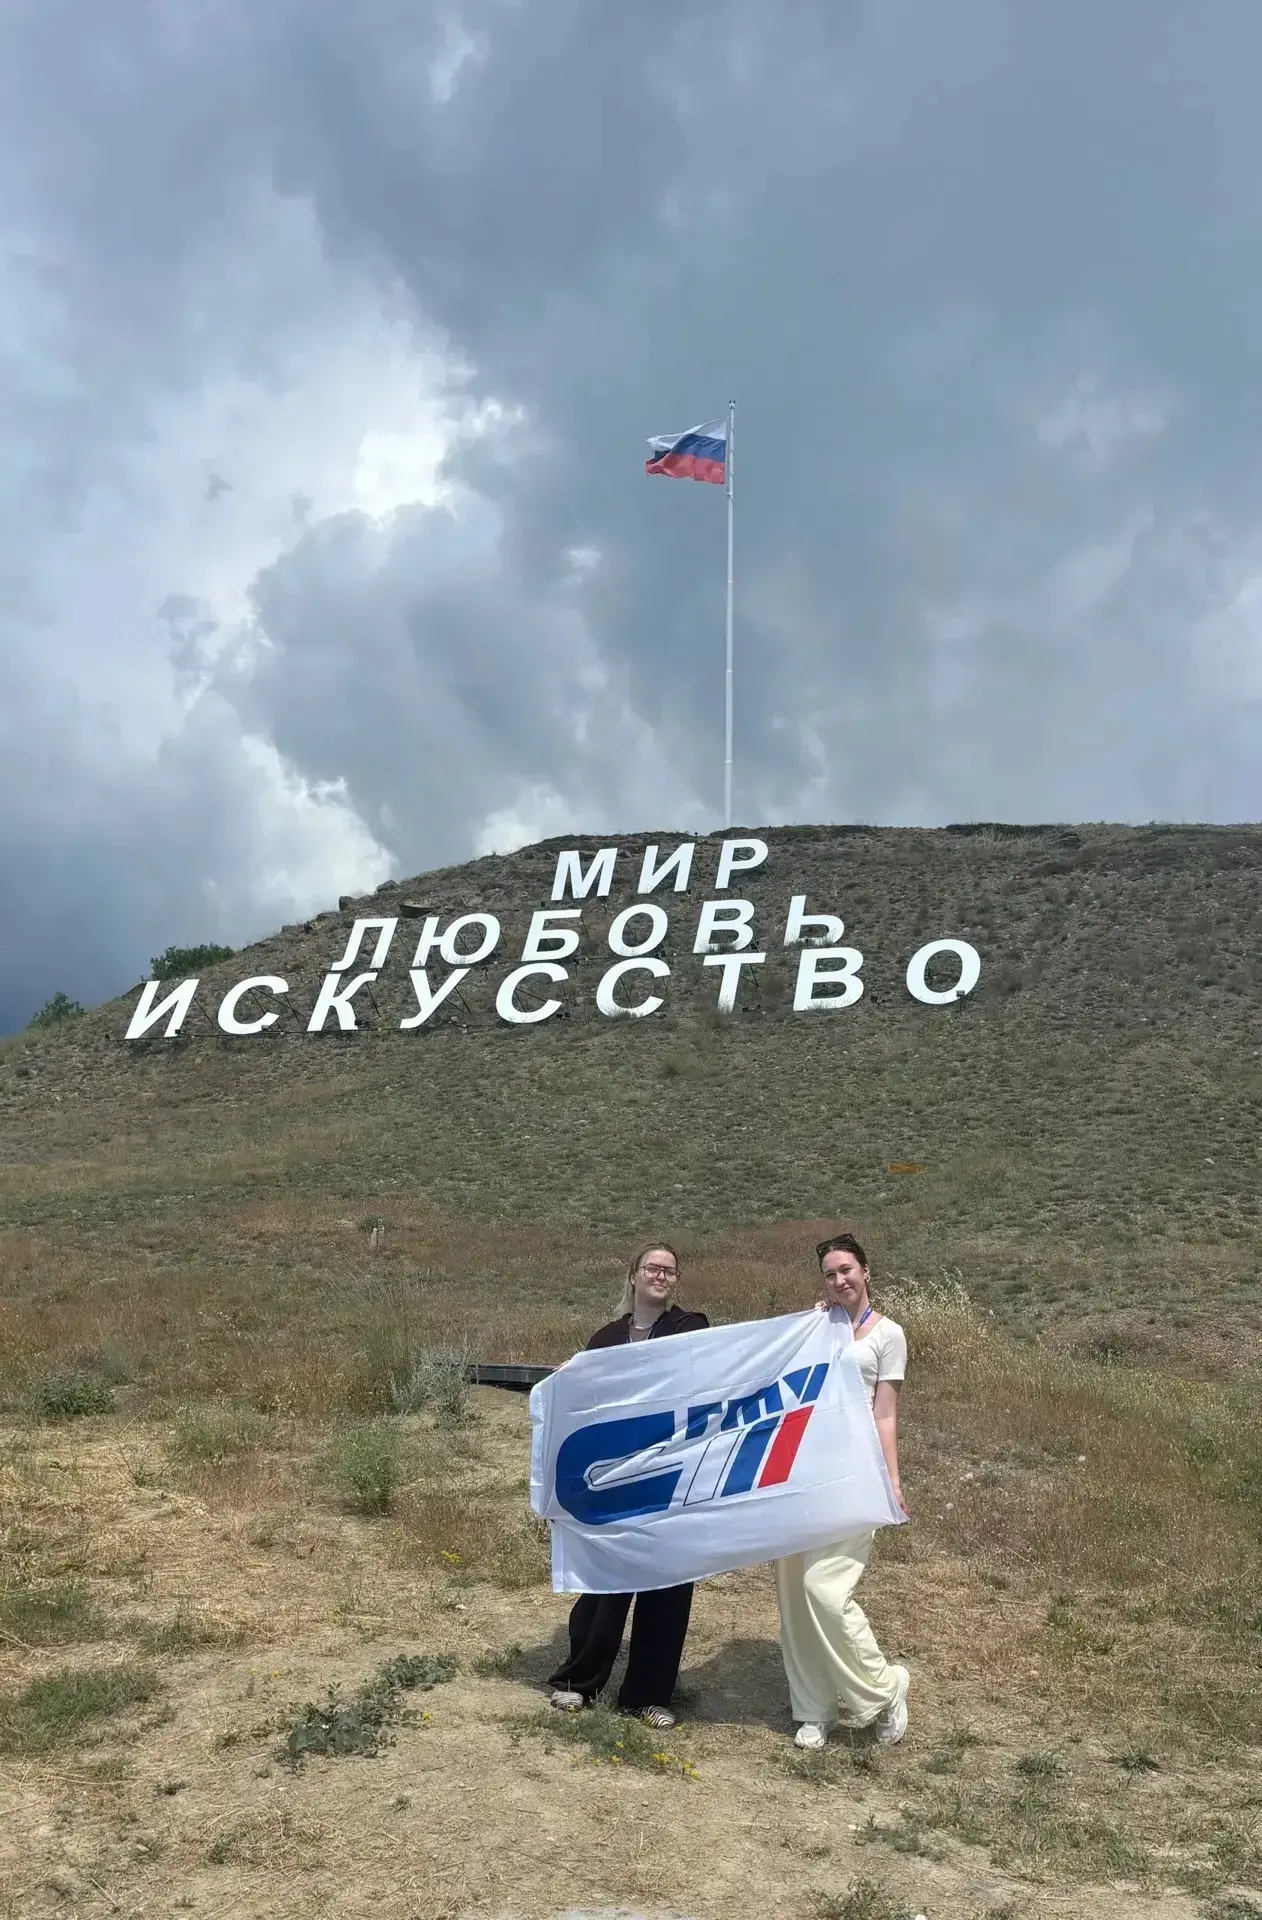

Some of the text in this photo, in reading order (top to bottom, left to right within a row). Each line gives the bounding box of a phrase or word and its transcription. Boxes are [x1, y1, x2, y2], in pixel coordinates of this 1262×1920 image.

[550, 838, 769, 901] МИР
[330, 894, 845, 971] ЛЮБОВЬ
[124, 938, 981, 1040] ИСКУССТВО
